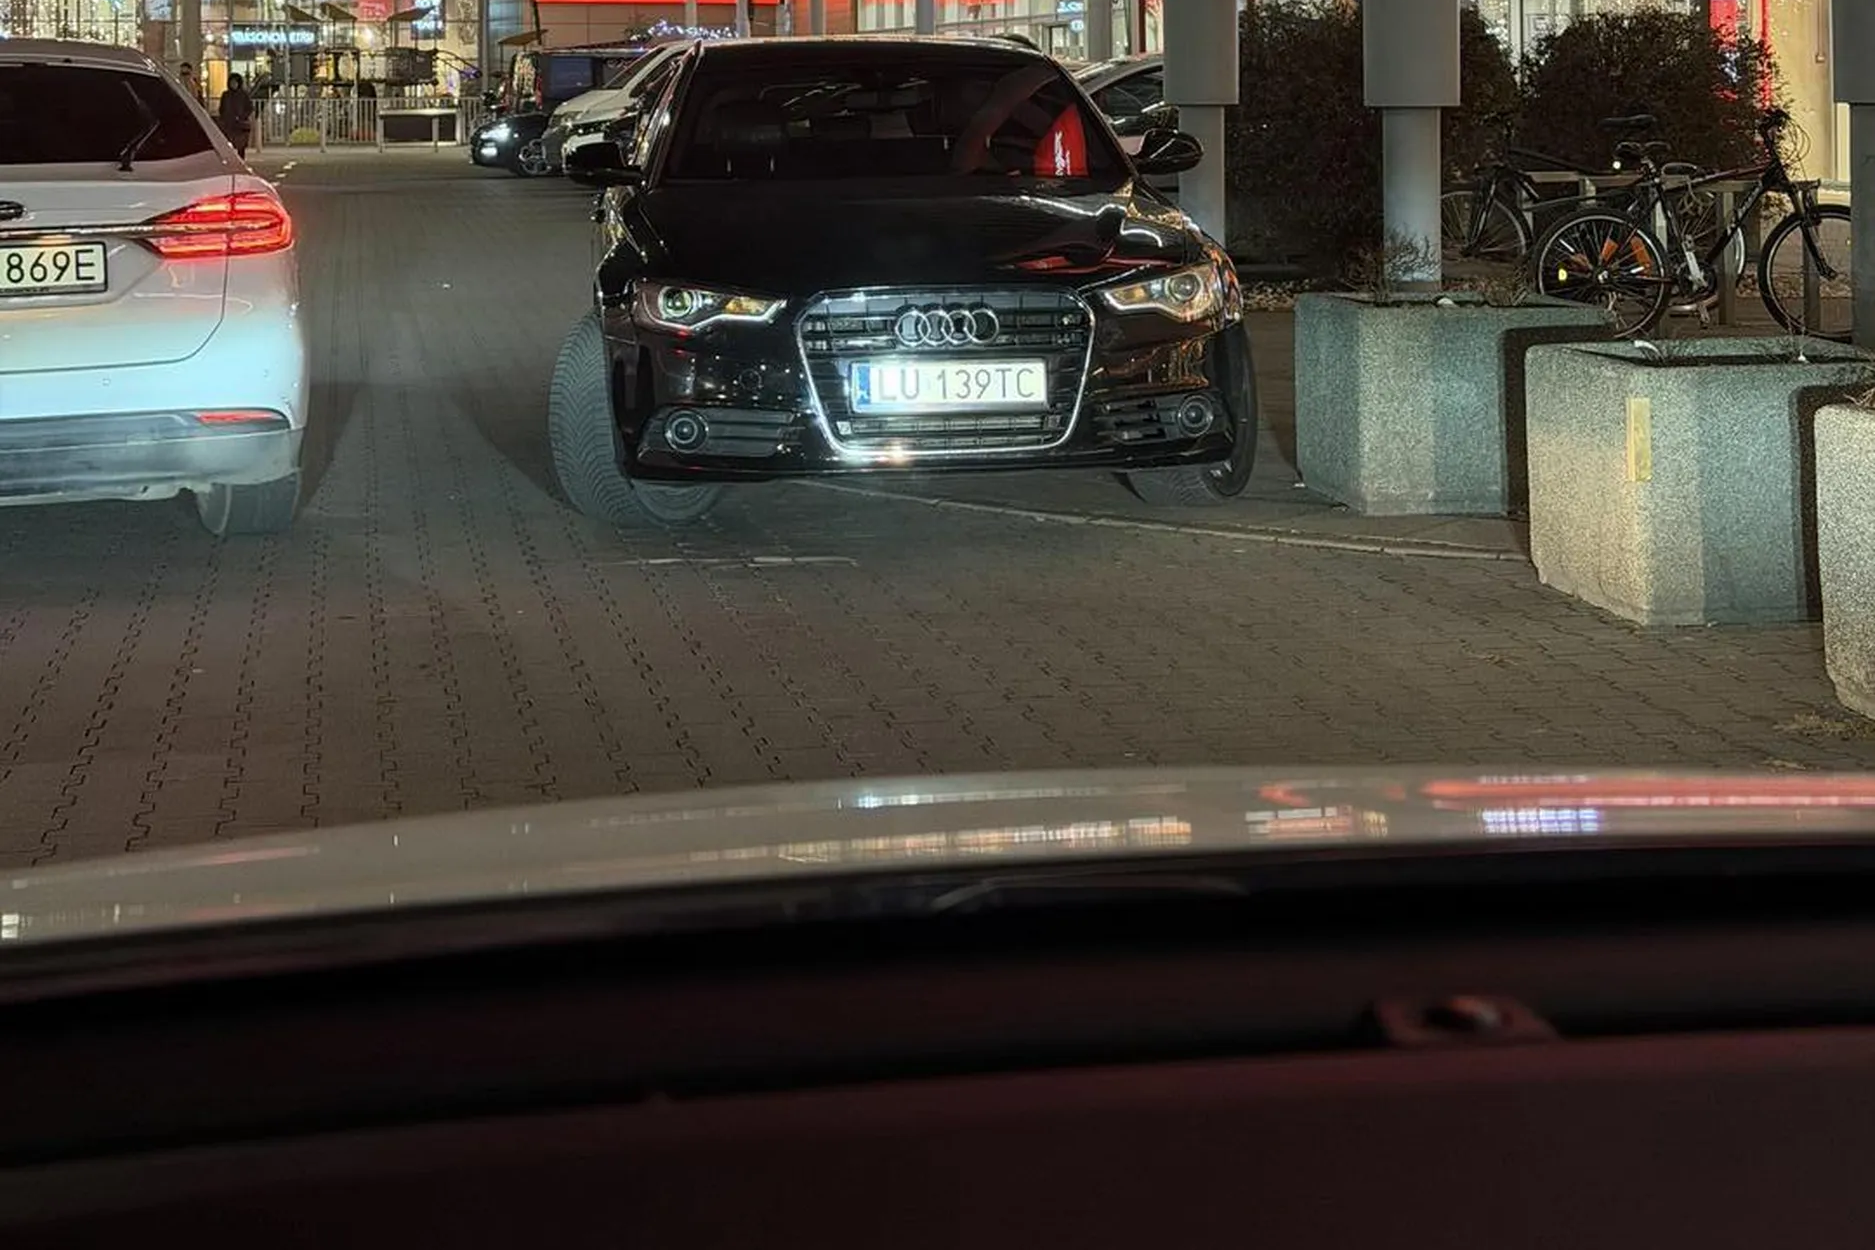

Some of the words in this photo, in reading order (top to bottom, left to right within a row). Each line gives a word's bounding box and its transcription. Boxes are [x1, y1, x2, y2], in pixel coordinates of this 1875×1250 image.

[6, 248, 96, 284] 869E
[878, 368, 920, 401] LU
[936, 367, 1035, 400] 139TC
